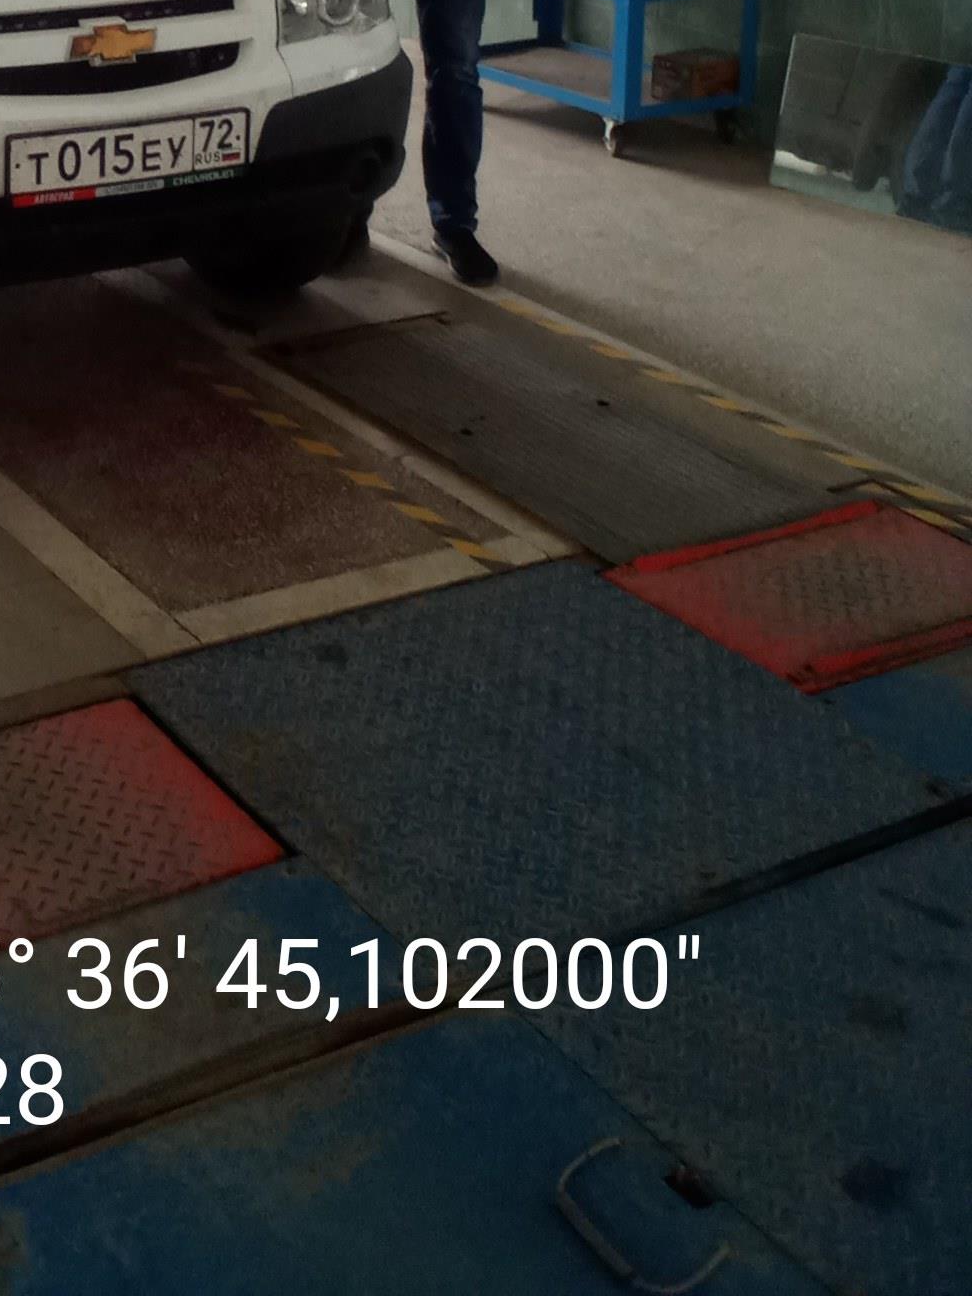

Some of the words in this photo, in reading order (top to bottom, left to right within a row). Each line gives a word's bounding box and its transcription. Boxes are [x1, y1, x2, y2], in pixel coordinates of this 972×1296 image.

[27, 134, 186, 186] Т015ЕУ
[199, 118, 233, 152] 72
[194, 151, 221, 165] RUS
